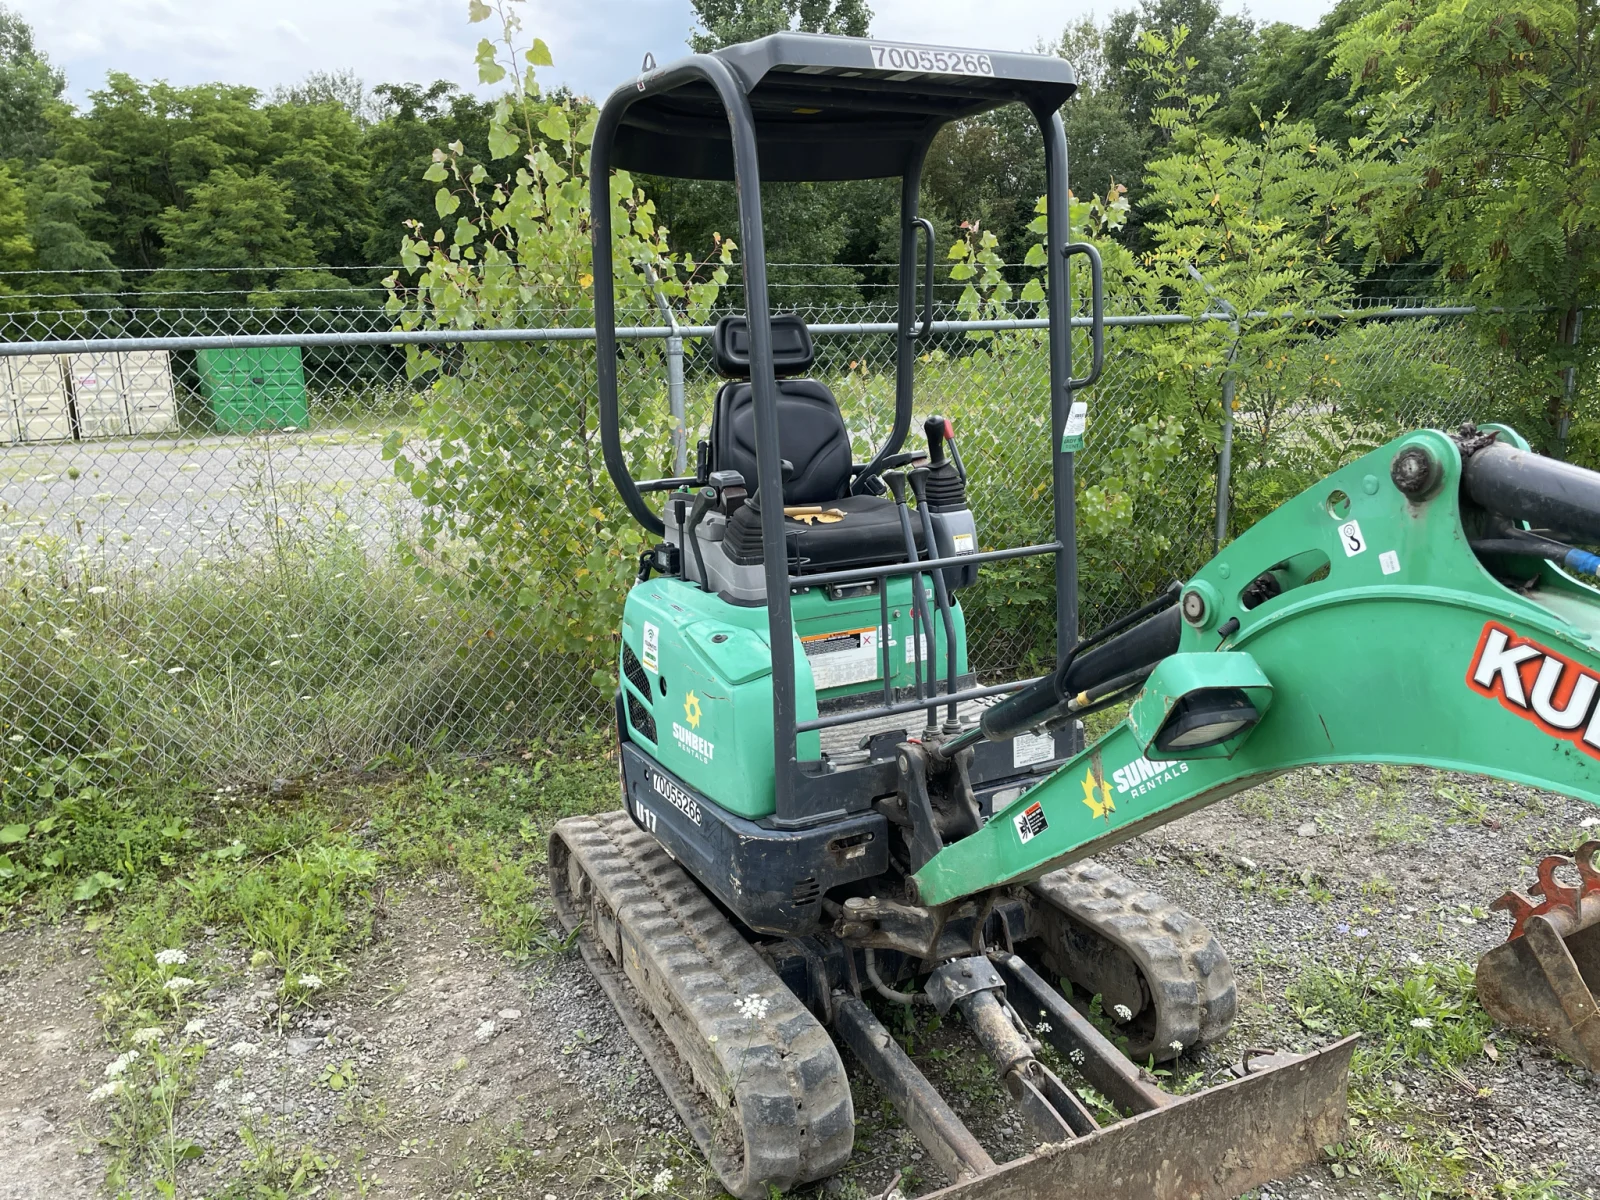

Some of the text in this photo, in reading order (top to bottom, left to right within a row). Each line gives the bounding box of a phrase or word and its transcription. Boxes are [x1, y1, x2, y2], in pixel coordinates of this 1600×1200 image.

[871, 46, 992, 75] 70055266
[1473, 628, 1600, 750] KU
[672, 721, 715, 760] SUNBELT
[677, 741, 708, 765] RENTALS
[1112, 755, 1181, 794] SUNB
[1130, 762, 1189, 799] RENTALS
[635, 799, 657, 833] U17
[654, 774, 703, 825] 70055266
